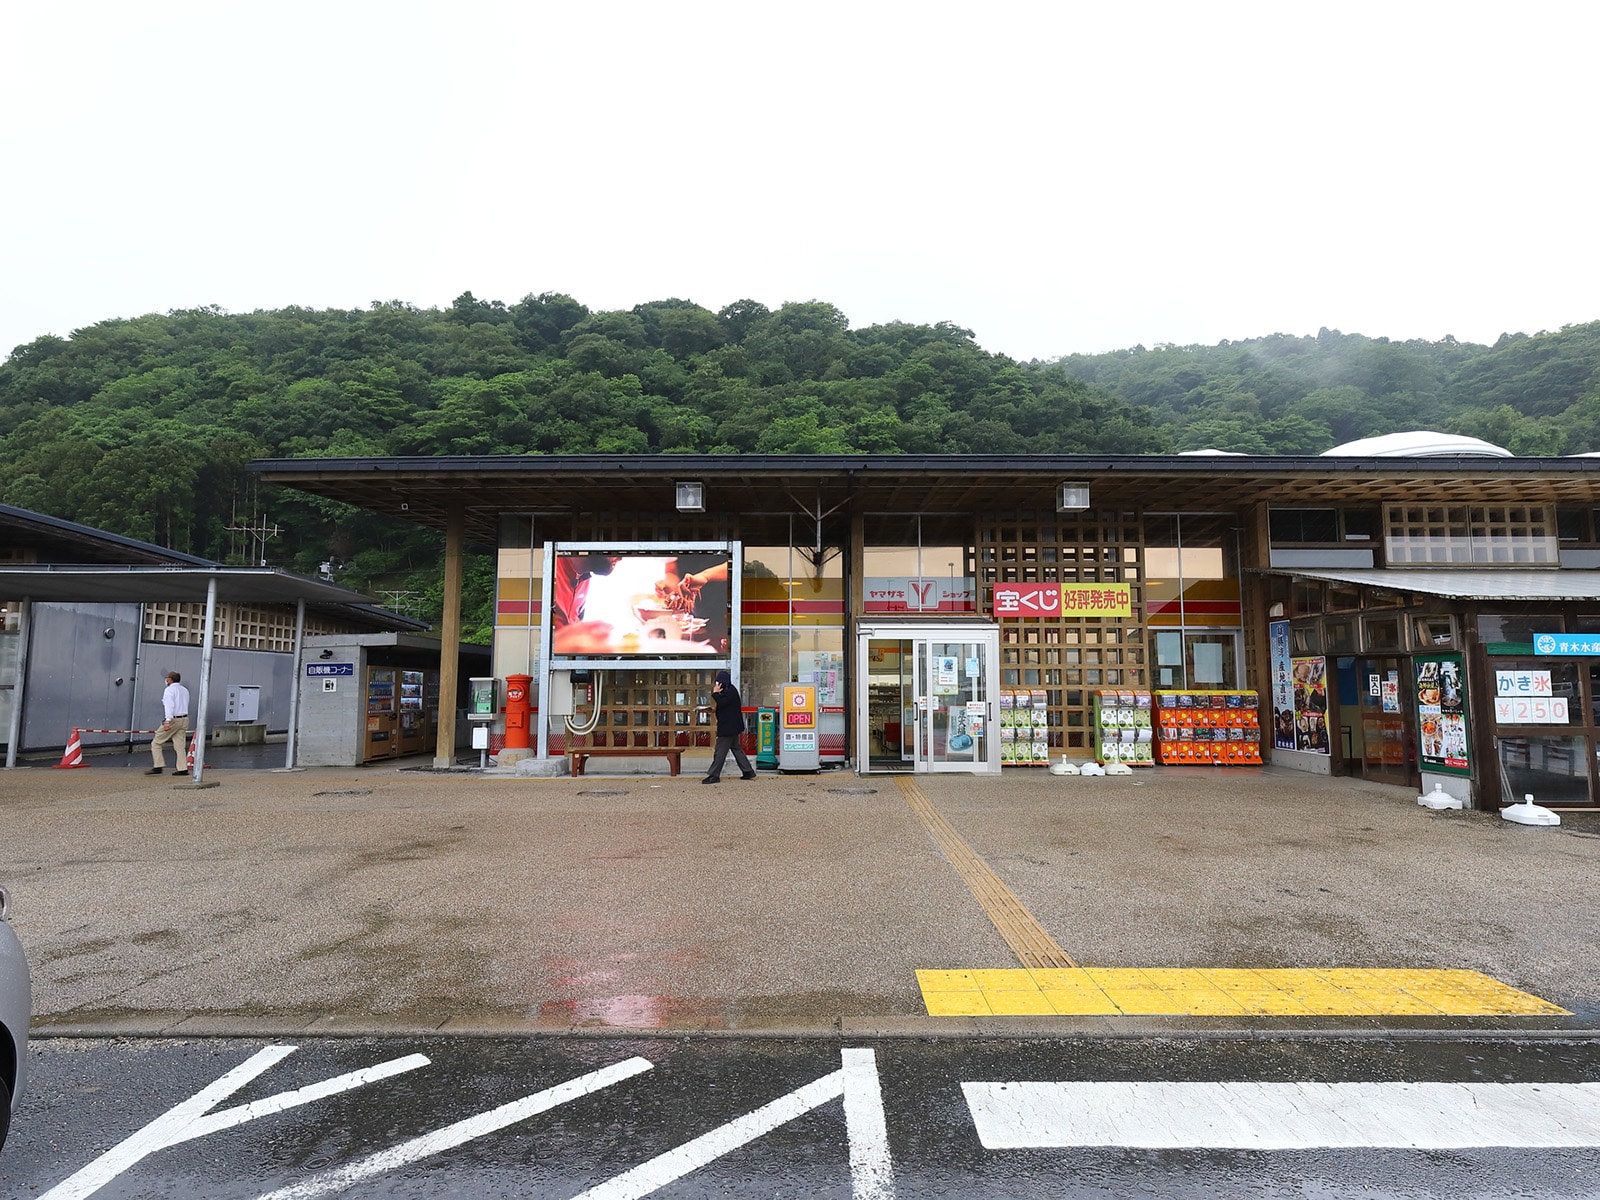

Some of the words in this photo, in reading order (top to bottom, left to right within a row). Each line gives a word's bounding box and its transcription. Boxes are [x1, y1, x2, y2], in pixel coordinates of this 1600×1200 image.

[869, 590, 905, 599] ヤマザキ
[942, 590, 971, 598] ショップ
[995, 589, 1059, 612] 宝くじ
[1064, 589, 1129, 610] 好評発売中
[308, 666, 353, 675] 自販機コーナー
[1370, 675, 1379, 695] 出入口
[1498, 675, 1551, 692] かき氷
[788, 713, 811, 724] OPEN
